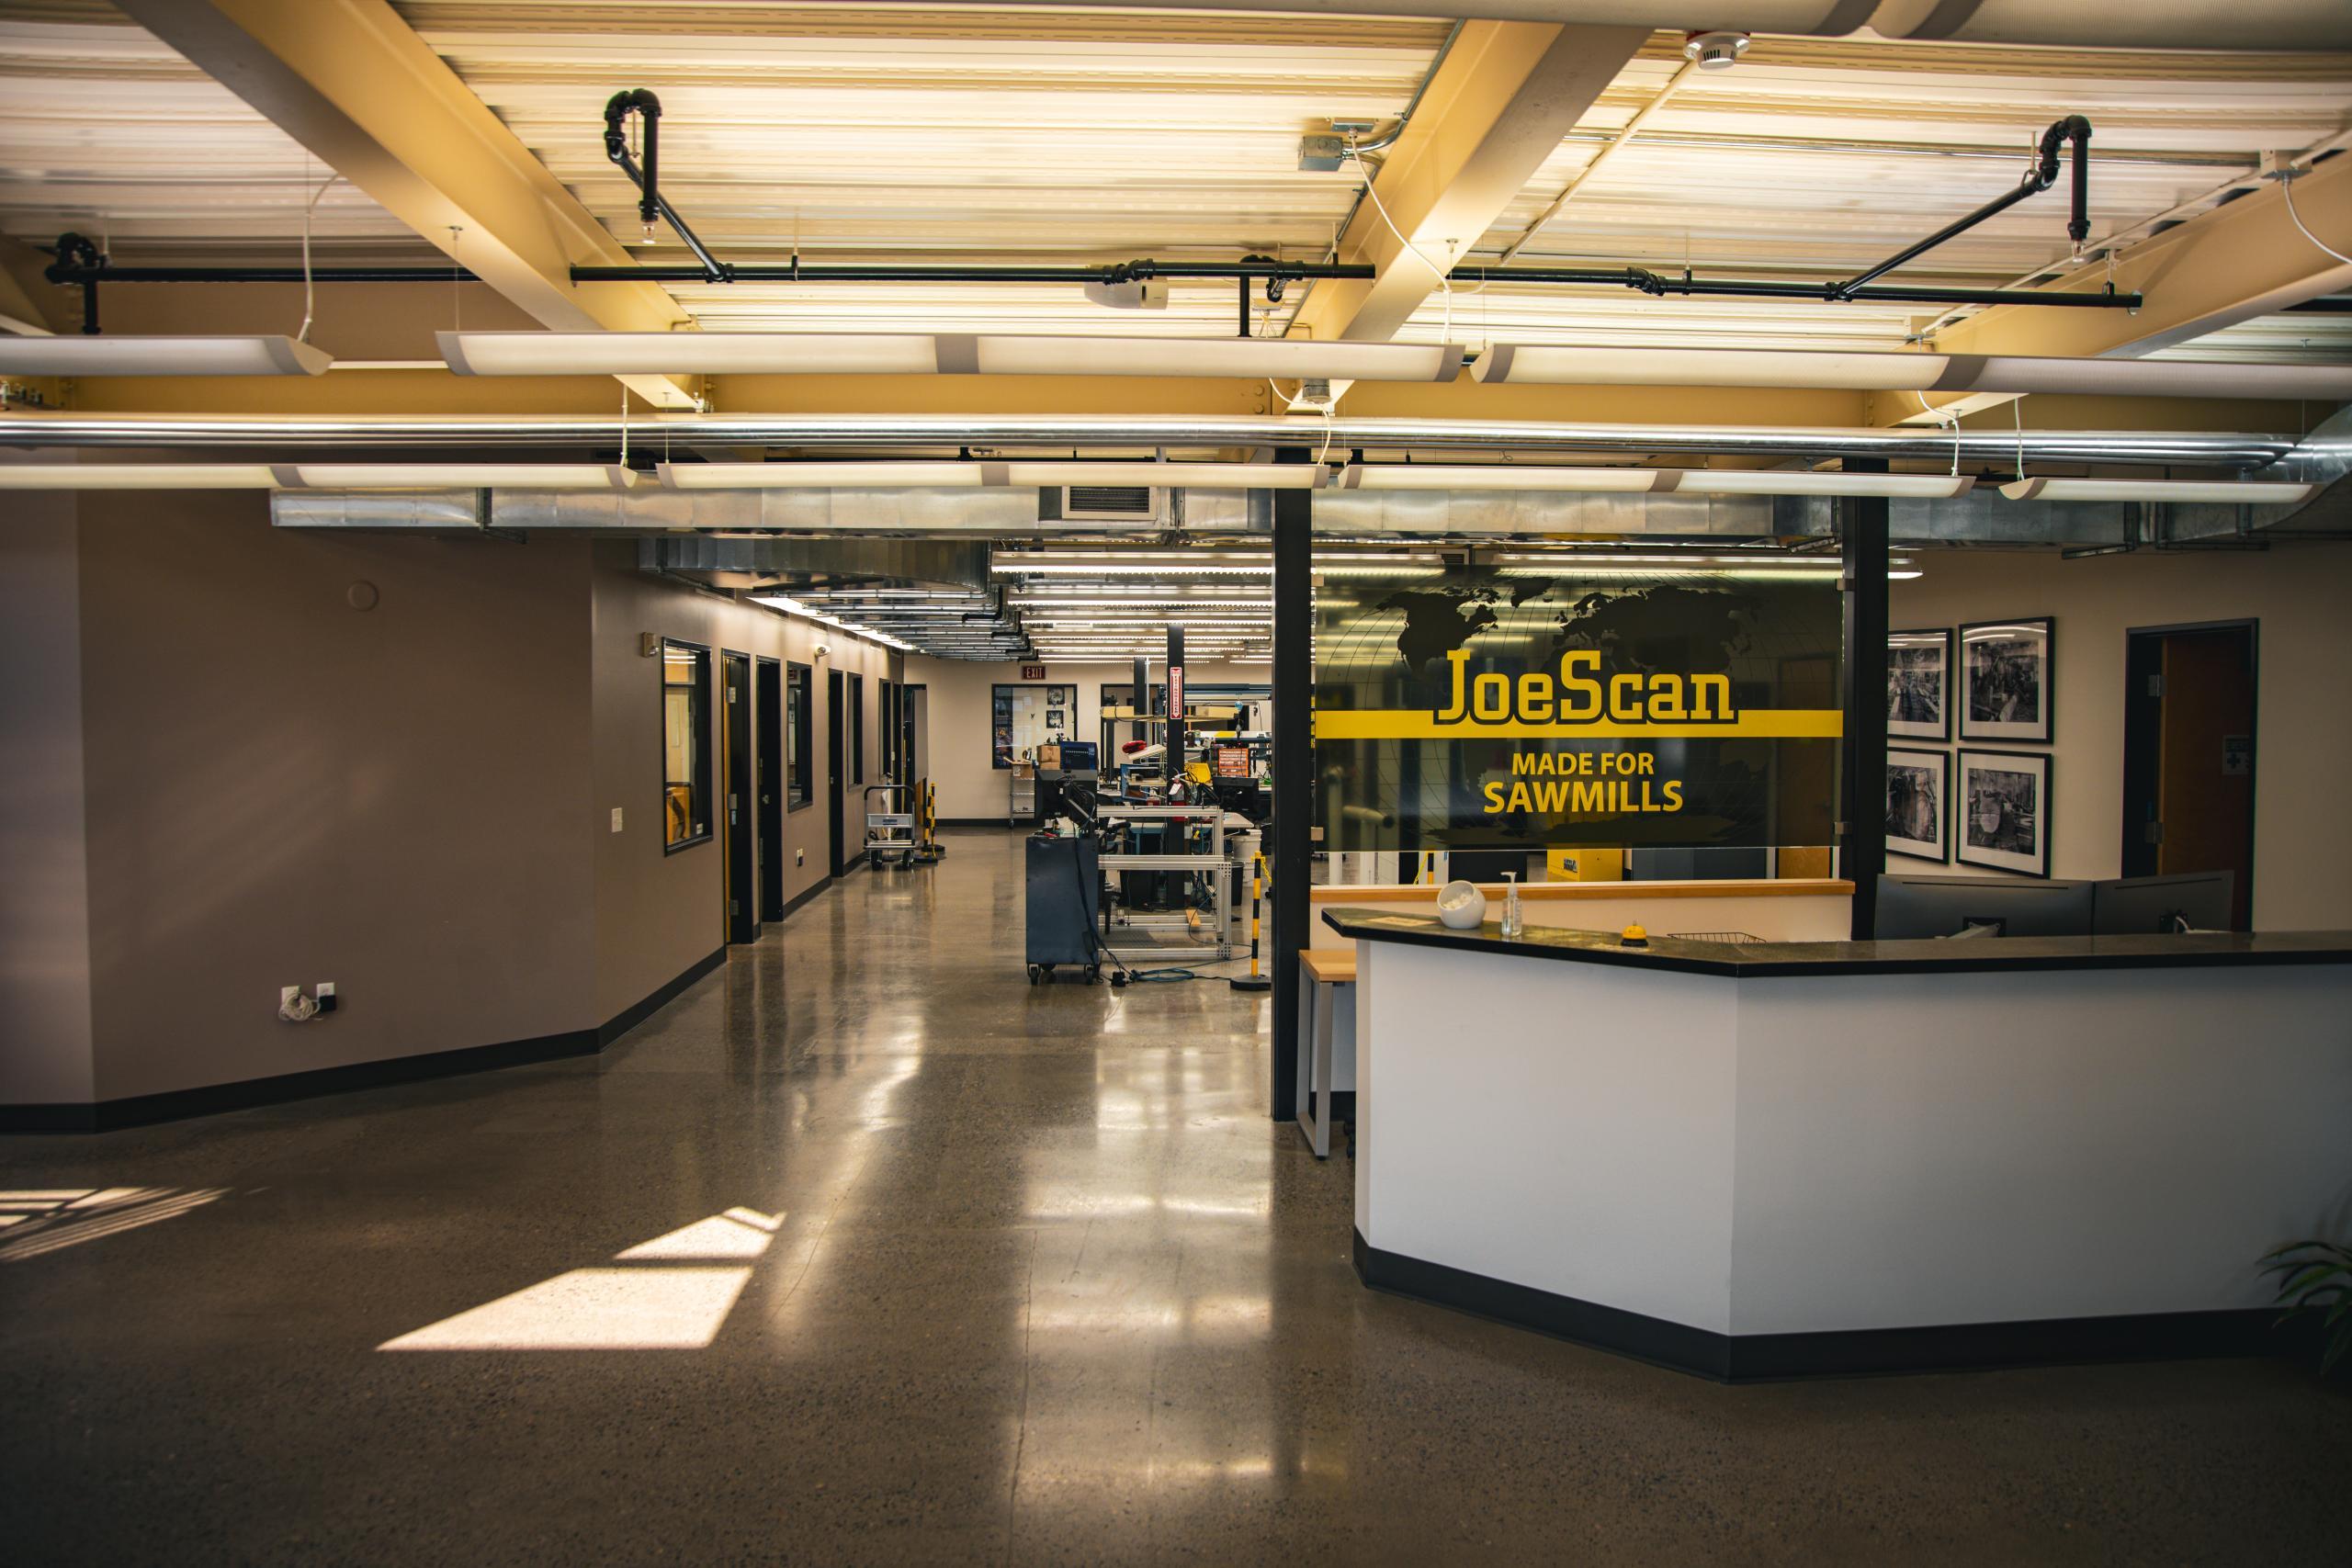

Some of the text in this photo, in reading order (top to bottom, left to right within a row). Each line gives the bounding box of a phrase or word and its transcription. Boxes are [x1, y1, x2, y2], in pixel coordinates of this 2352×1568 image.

[1026, 667, 1043, 679] EXIT
[1438, 649, 1735, 720] JoeScan
[1511, 751, 1655, 776] MADE FOR
[1484, 781, 1683, 814] SAWMILLS
